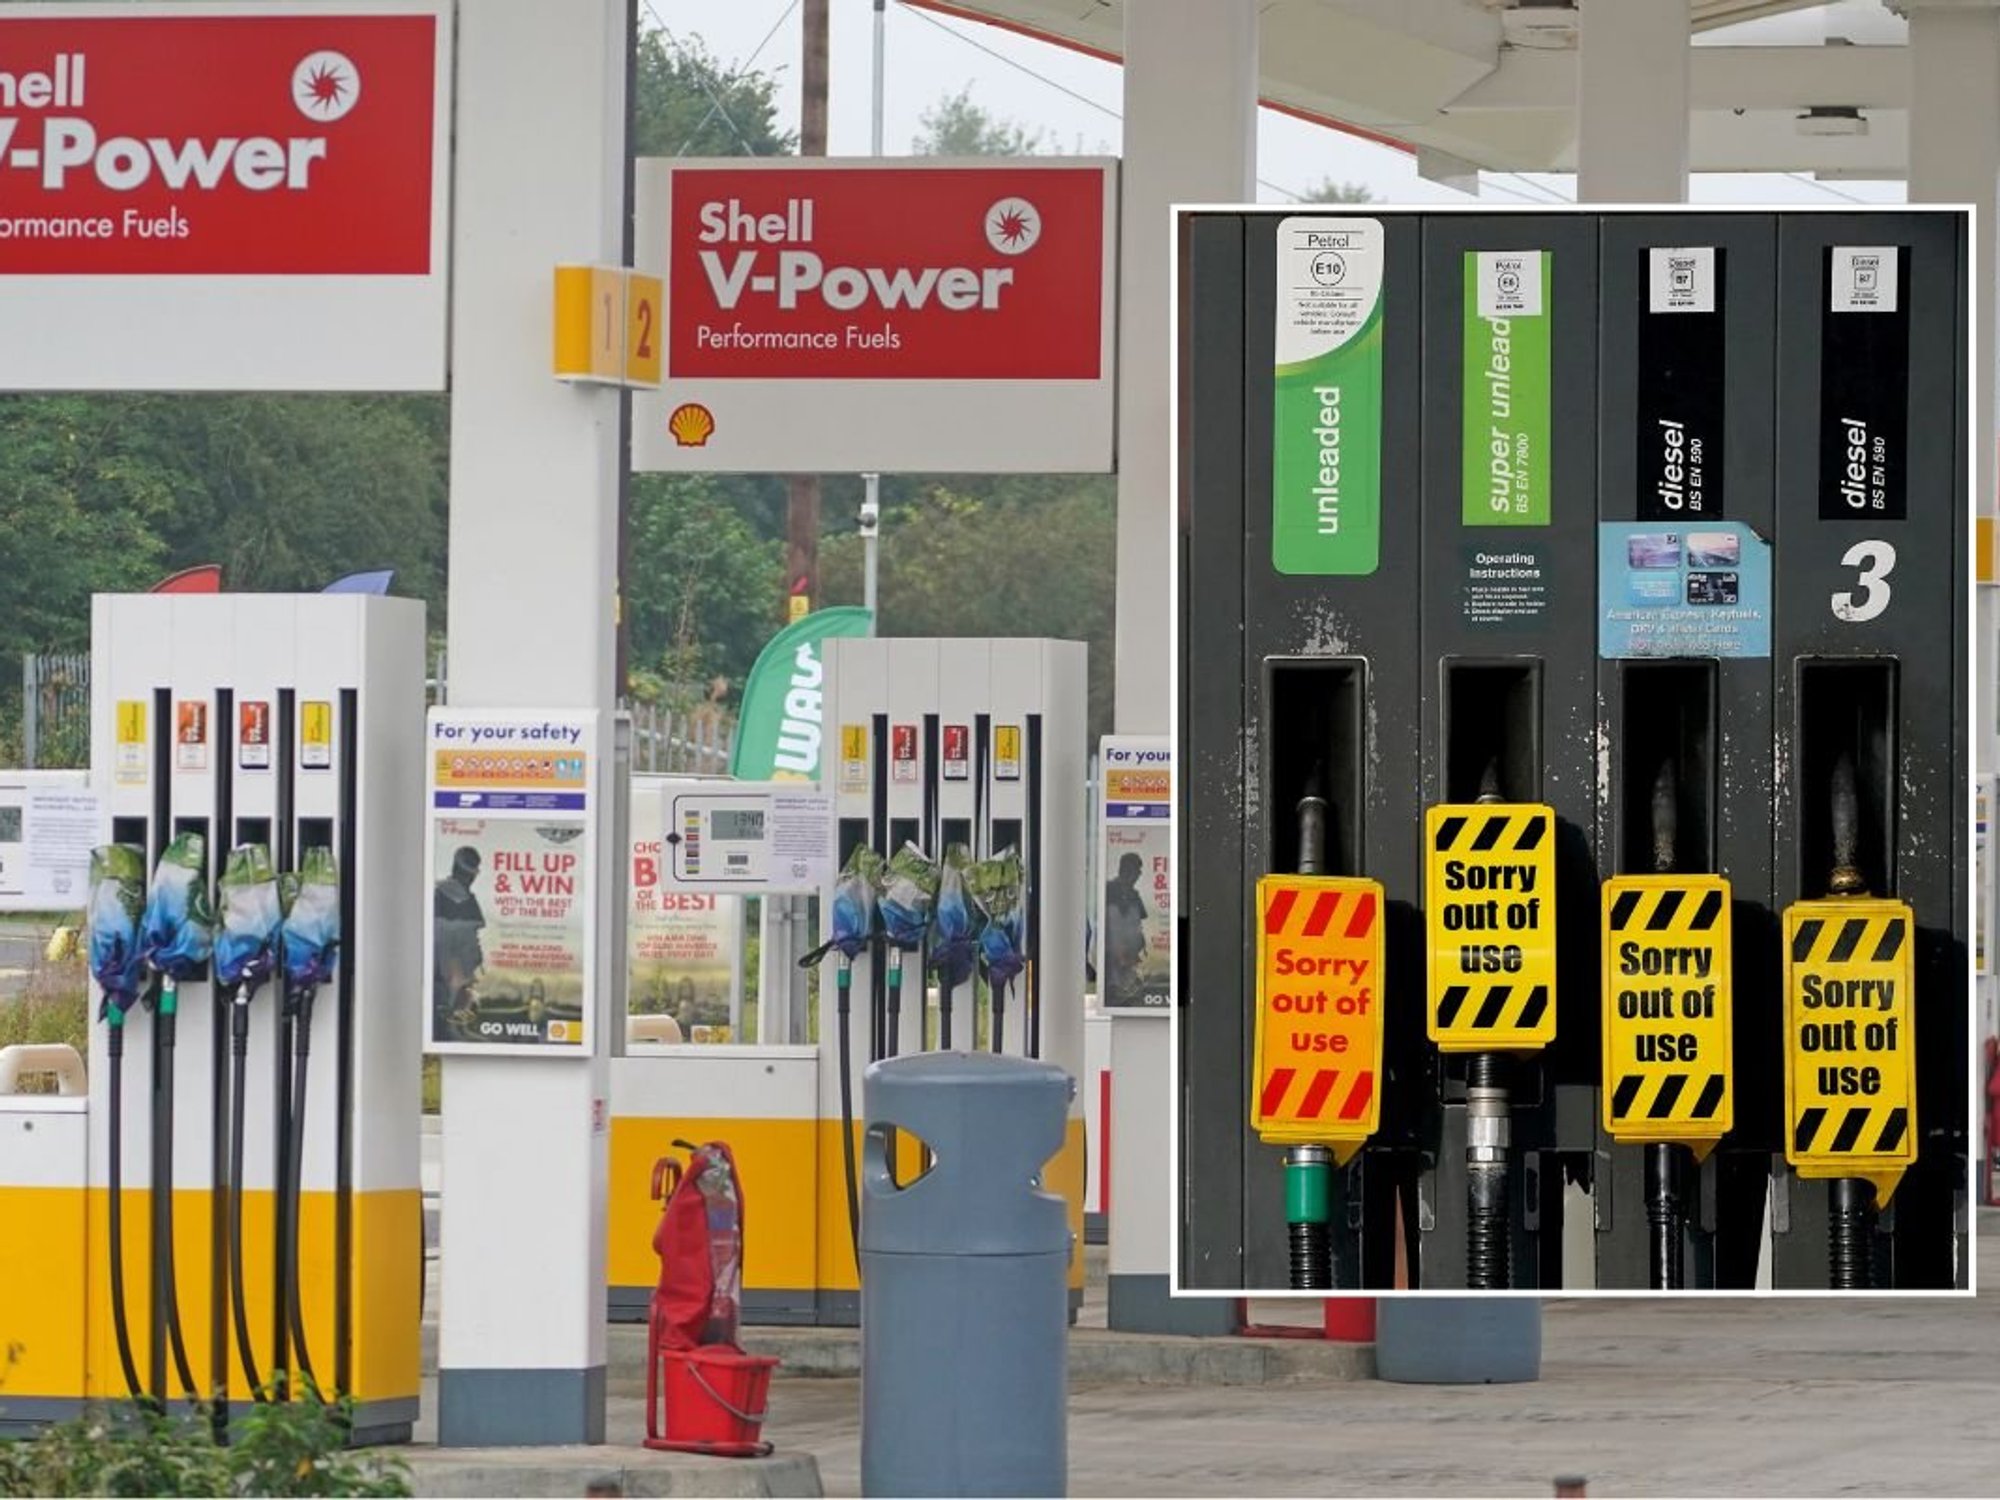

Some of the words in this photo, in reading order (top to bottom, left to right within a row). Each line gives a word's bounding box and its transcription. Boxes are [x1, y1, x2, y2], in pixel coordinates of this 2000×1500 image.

[0, 117, 327, 190] -Power
[122, 206, 190, 239] Fuels
[699, 198, 813, 243] Shell
[1308, 234, 1350, 247] Petrol
[698, 250, 1014, 311] V-Power
[1315, 262, 1342, 275] E10
[603, 292, 612, 351] 1
[637, 298, 652, 359] 2
[698, 323, 838, 349] Performance
[845, 324, 901, 349] Fuels
[1312, 386, 1340, 534] unleaded
[1658, 419, 1684, 510] diesel
[1689, 438, 1703, 464] 590
[1841, 417, 1866, 508] diesel
[1490, 426, 1515, 513] super
[1516, 471, 1528, 490] EN
[1689, 466, 1702, 487] EN
[1872, 465, 1885, 486] EN
[1516, 493, 1528, 513] BS
[1689, 490, 1702, 511] BS
[1872, 489, 1885, 510] BS
[1475, 552, 1535, 565] Operating
[1469, 568, 1541, 579] Instructions
[1830, 539, 1897, 623] 3
[435, 723, 465, 739] For
[472, 727, 516, 743] your
[521, 723, 581, 744] safety
[1107, 748, 1131, 761] For
[494, 853, 537, 872] FILL
[543, 854, 577, 873] UP
[1445, 860, 1536, 892] Sorry
[495, 874, 512, 894] &
[520, 875, 575, 896] WIN
[1154, 874, 1168, 891] &
[1443, 902, 1498, 930] out
[1507, 898, 1540, 930] of
[1275, 948, 1370, 985] Sorry
[1460, 945, 1522, 973] use
[1618, 941, 1712, 977] Sorry
[1272, 992, 1328, 1015] out
[1336, 988, 1371, 1016] of
[1618, 990, 1674, 1019] out
[1682, 985, 1715, 1019] of
[1801, 974, 1895, 1011] Sorry
[480, 1022, 502, 1035] GO
[505, 1023, 540, 1036] WELL
[1291, 1032, 1348, 1053] use
[1800, 1020, 1856, 1052] out
[1865, 1018, 1898, 1052] of
[1635, 1033, 1698, 1062] use
[1818, 1066, 1881, 1095] use
